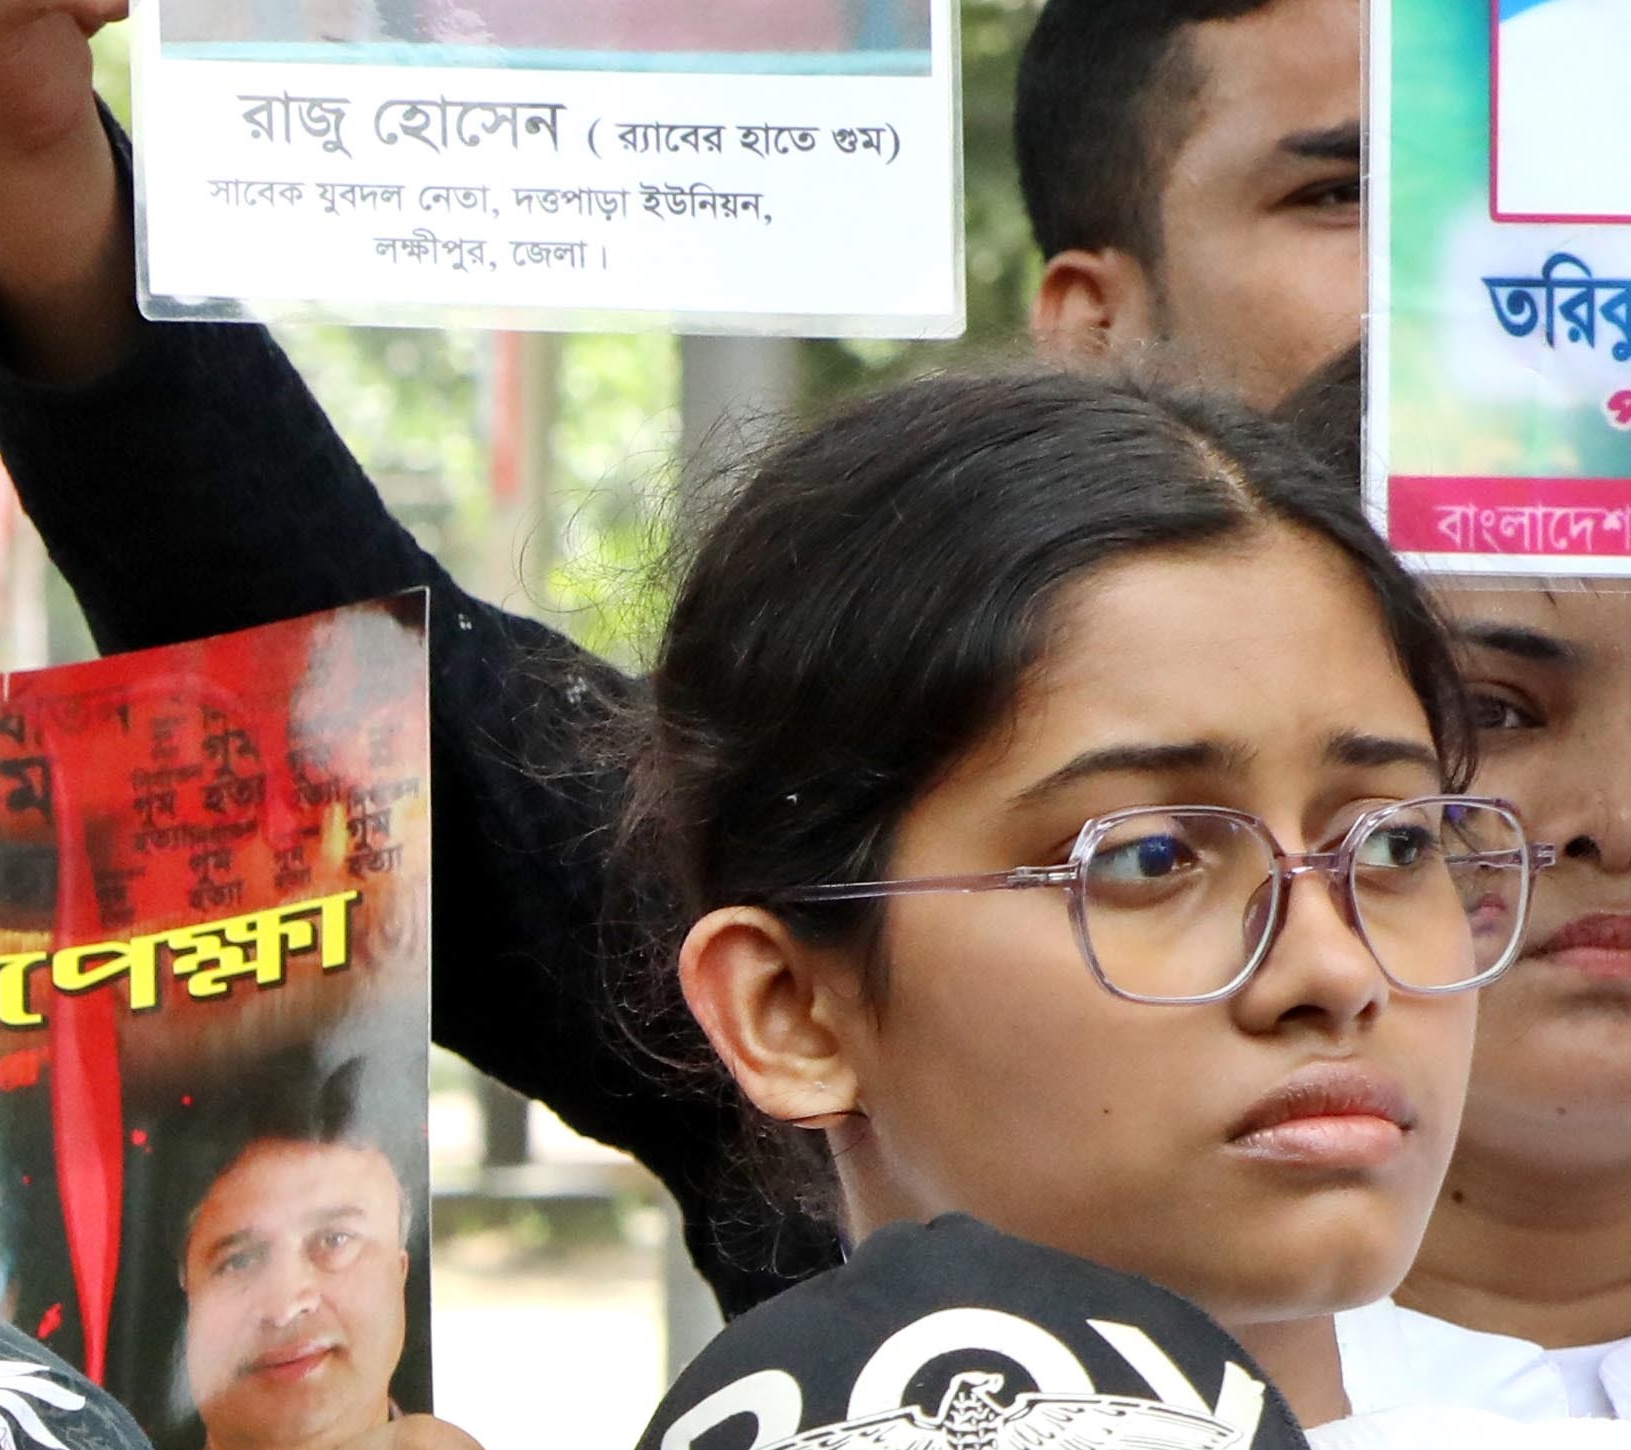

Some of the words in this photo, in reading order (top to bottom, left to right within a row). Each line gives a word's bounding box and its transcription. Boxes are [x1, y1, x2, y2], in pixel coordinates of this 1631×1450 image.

[237, 90, 352, 155] রাজু
[375, 95, 566, 153] হোসেন
[736, 122, 820, 159] হাতে
[207, 178, 306, 207] সাবেক
[315, 182, 406, 216] যুবদল
[419, 184, 500, 219] নেতা,
[639, 180, 772, 226] ইউনিয়ন,
